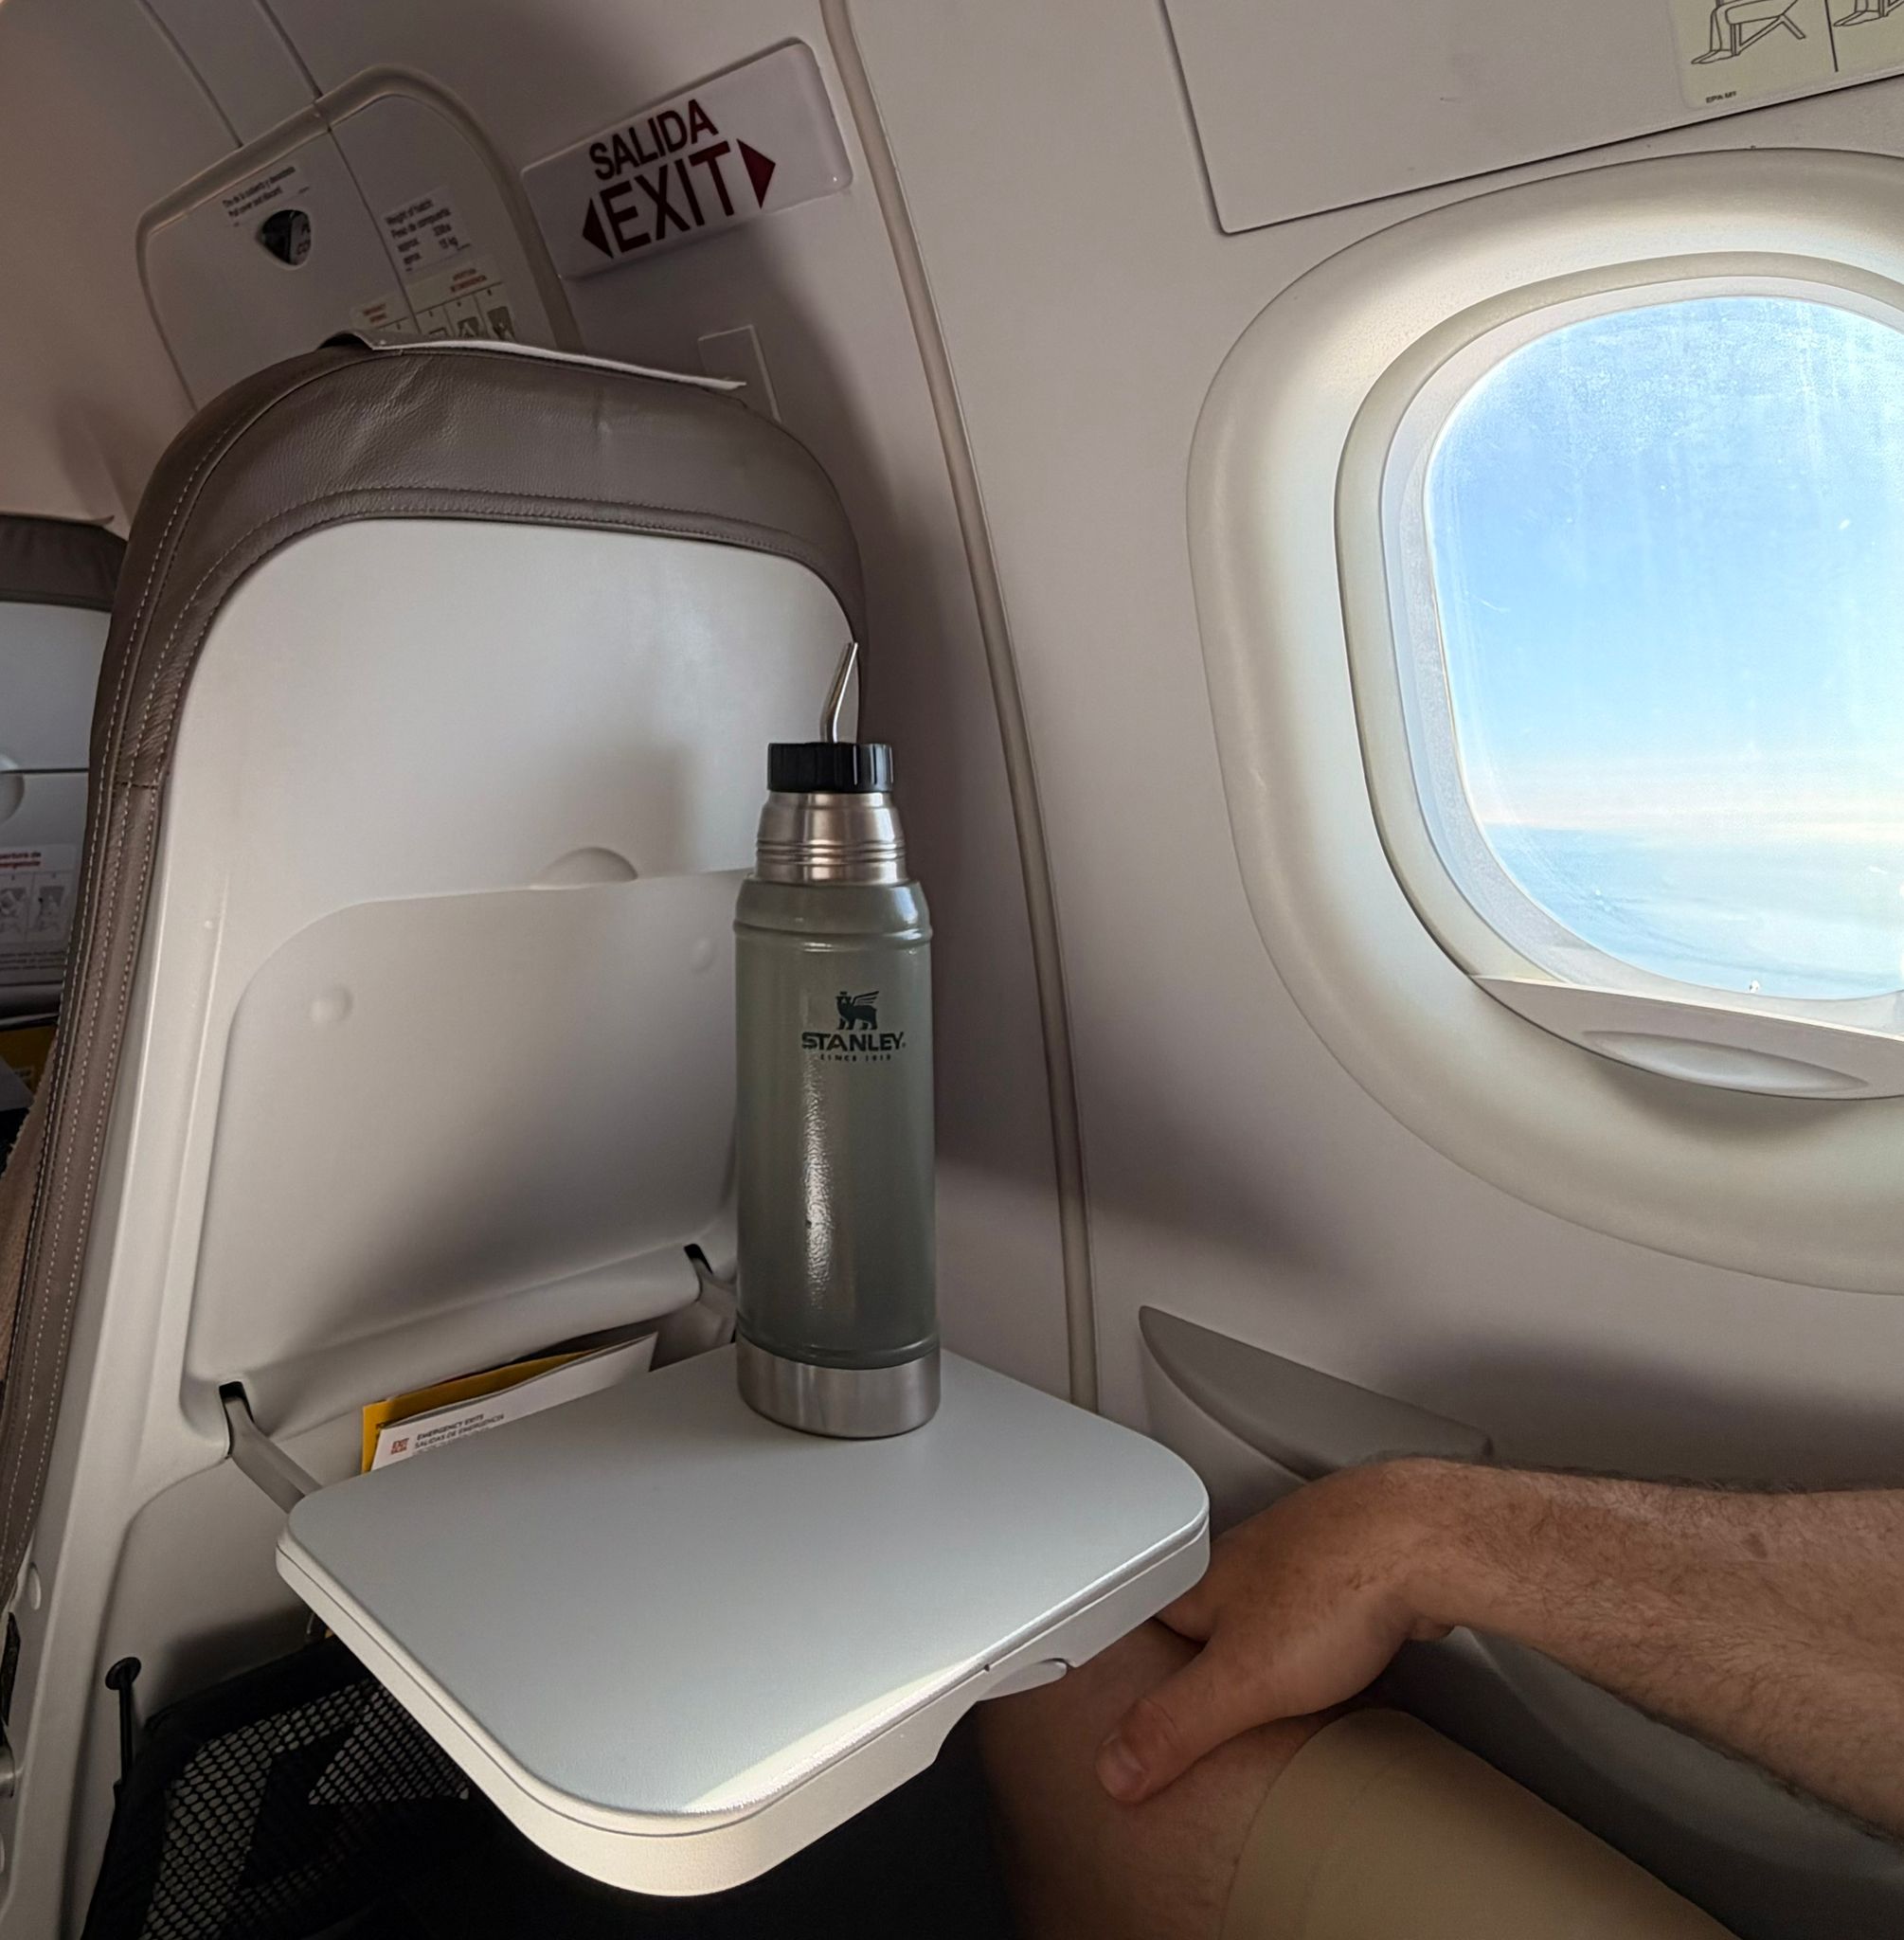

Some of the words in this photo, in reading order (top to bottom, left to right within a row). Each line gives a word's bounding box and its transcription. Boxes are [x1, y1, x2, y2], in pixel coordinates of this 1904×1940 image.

[589, 99, 719, 180] SALIDA
[599, 140, 734, 253] EXIT
[801, 1031, 905, 1052] STANLEY
[820, 1053, 856, 1062] SINCE
[415, 1433, 445, 1448] SALIDAS
[446, 1429, 457, 1440] DE
[458, 1413, 505, 1435] EMERGENCIA
[417, 1420, 462, 1441] EMERGENCY
[464, 1413, 485, 1428] EXITS
